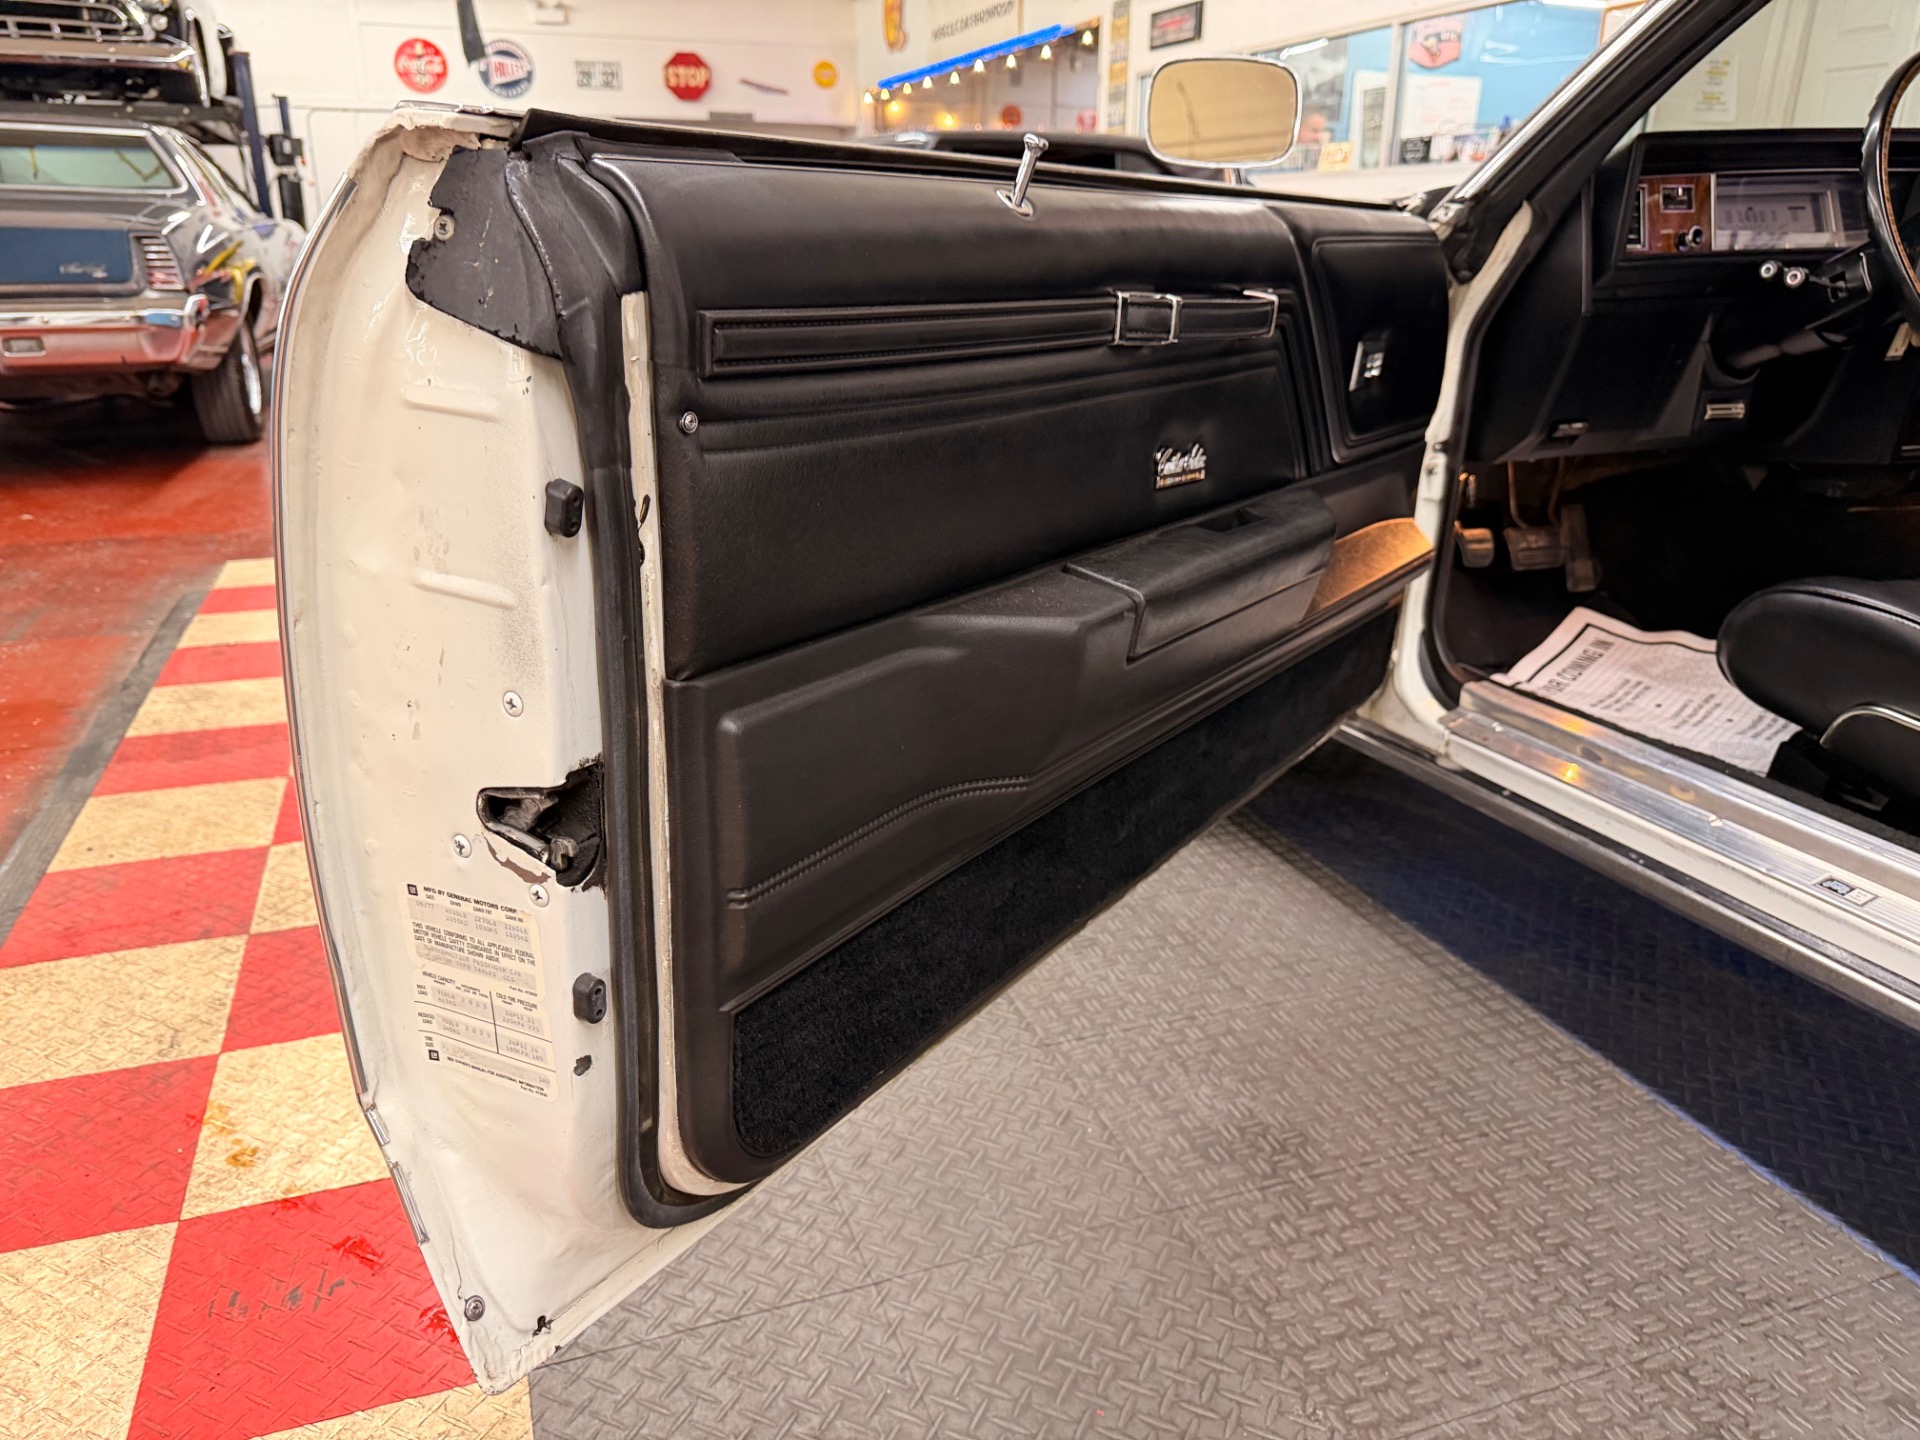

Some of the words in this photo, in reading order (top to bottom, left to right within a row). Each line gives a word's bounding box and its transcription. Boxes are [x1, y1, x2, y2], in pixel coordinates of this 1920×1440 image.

[668, 65, 707, 88] STOP
[1557, 648, 1605, 681] COMING
[446, 891, 472, 904] GENERAL
[473, 898, 499, 910] MOTORS
[448, 937, 465, 947] SAFETY
[477, 938, 485, 947] ALL
[517, 999, 538, 1010] PRESSURE
